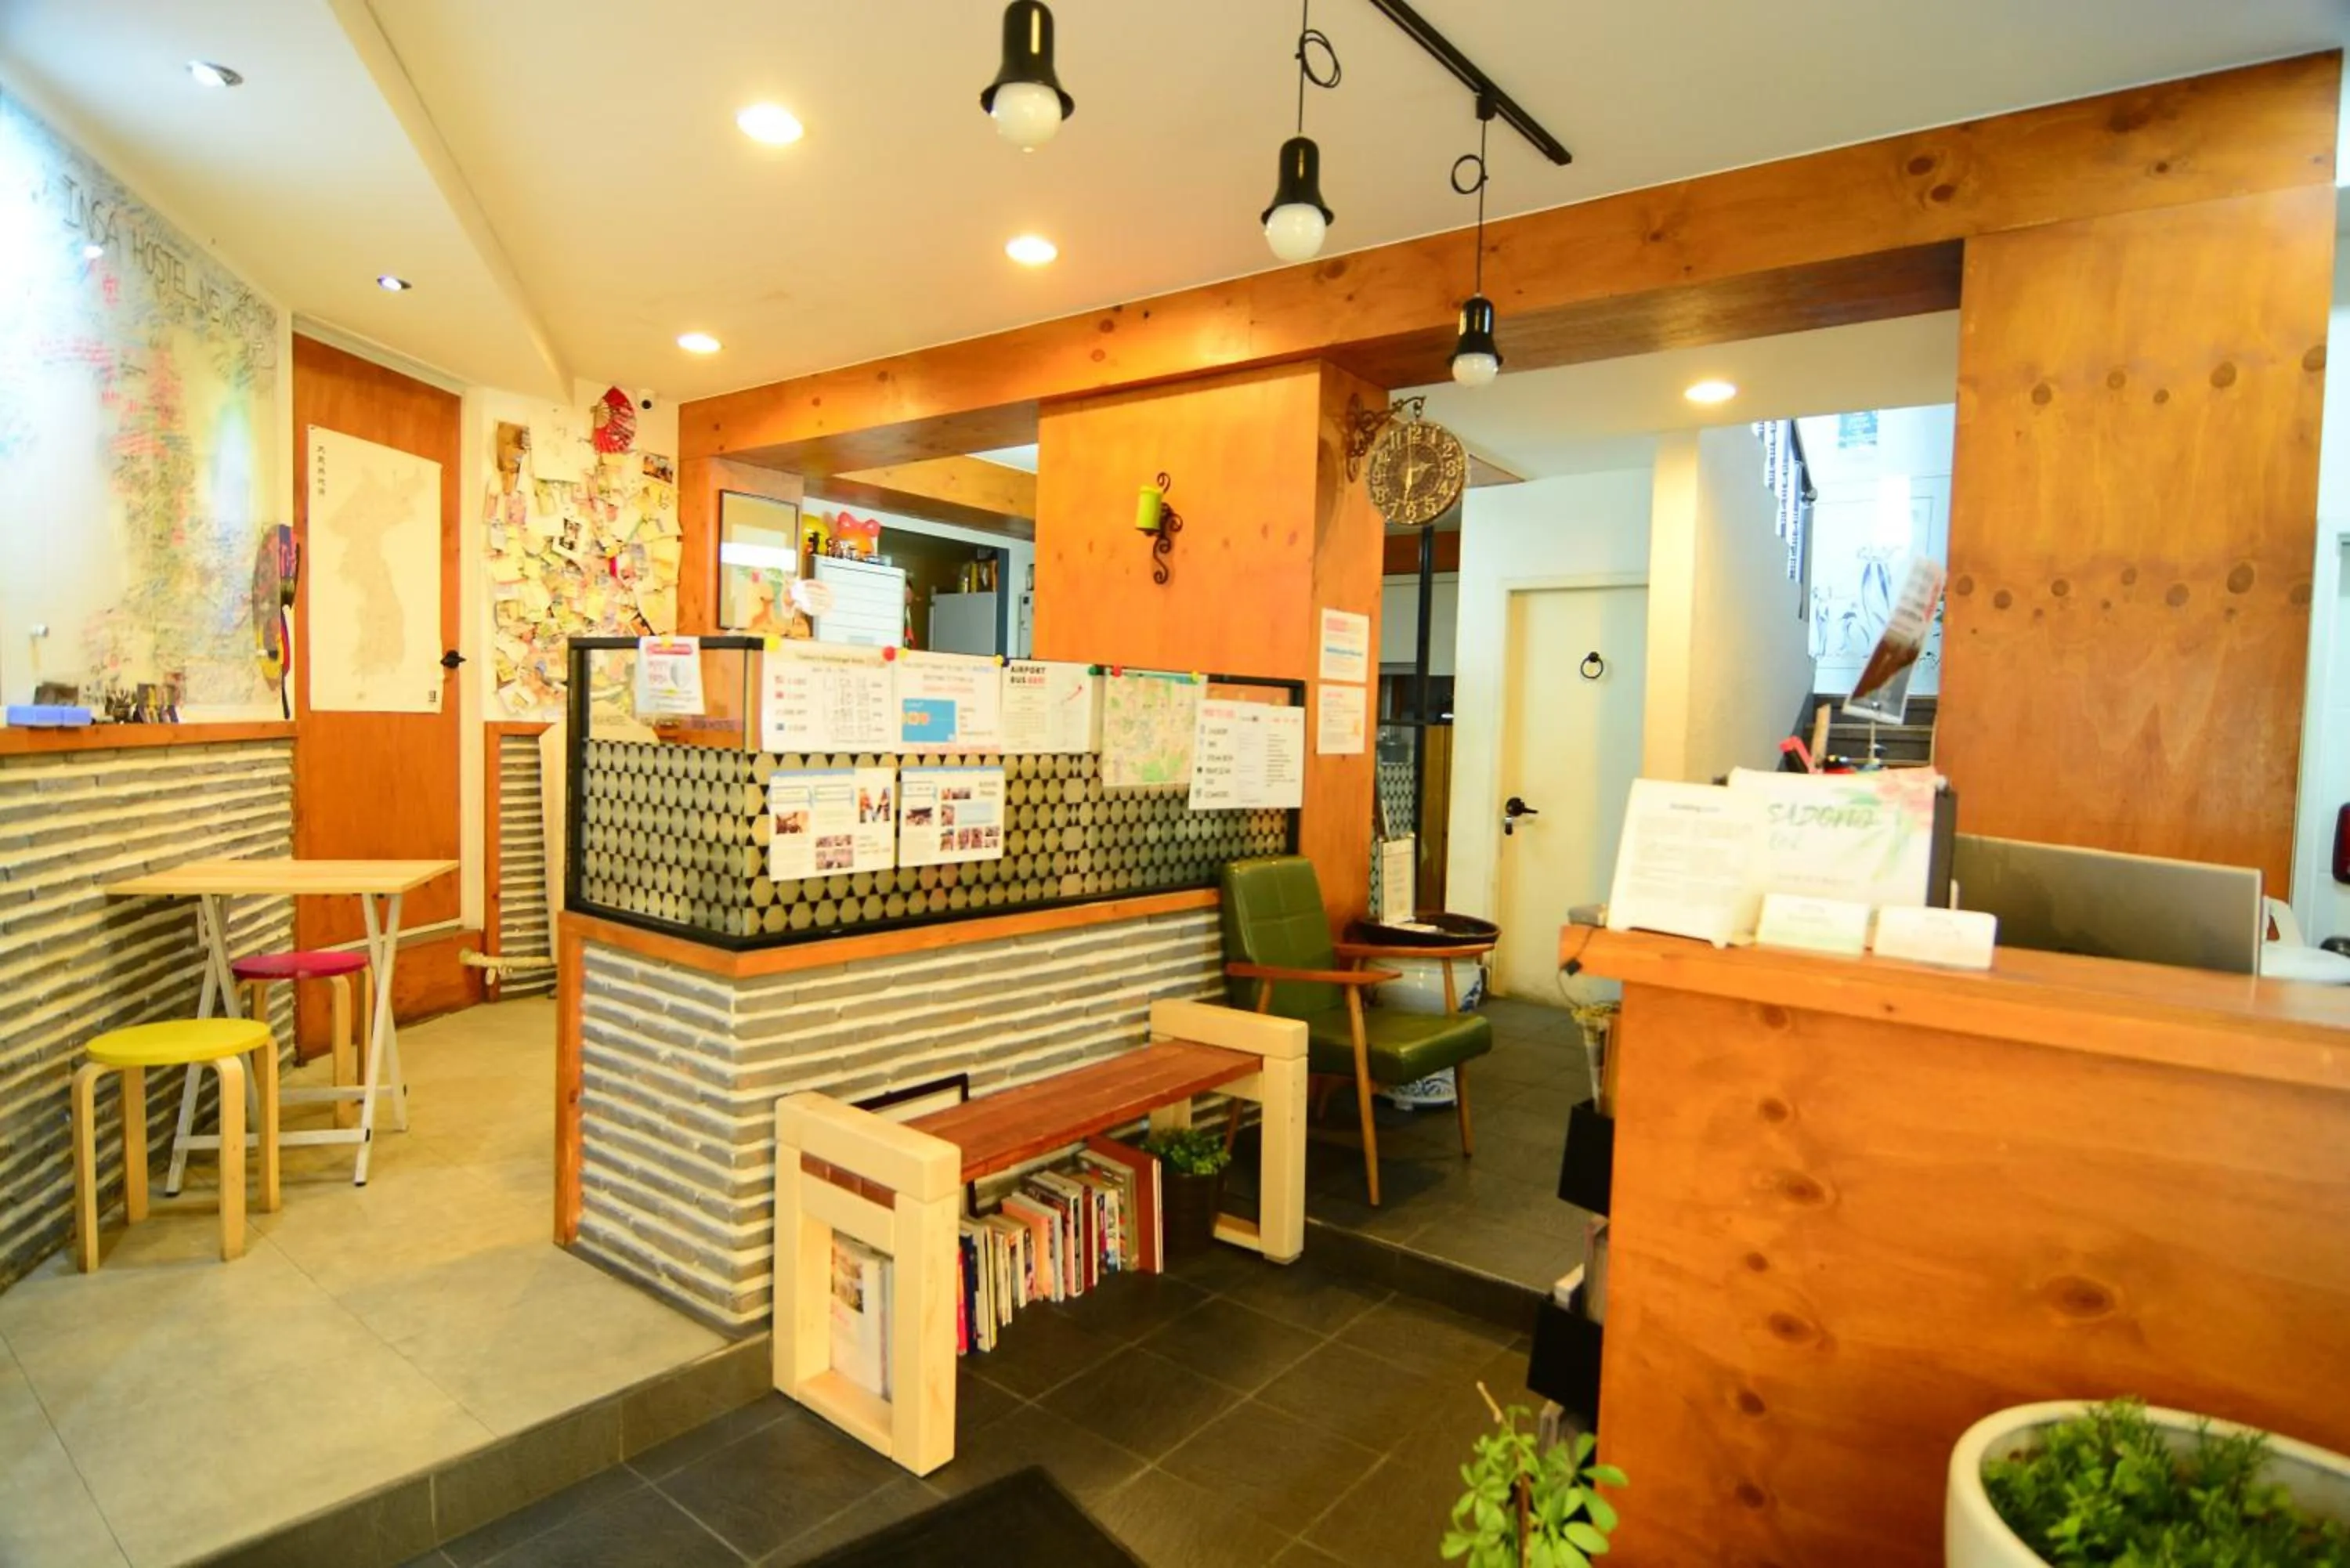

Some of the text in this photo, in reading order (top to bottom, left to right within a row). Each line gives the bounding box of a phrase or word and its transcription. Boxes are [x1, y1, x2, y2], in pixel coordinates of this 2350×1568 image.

[63, 174, 121, 263] INSA
[132, 227, 197, 302] HOSTEL
[1390, 430, 1401, 450] 11
[1442, 443, 1453, 458] 2
[1445, 460, 1457, 477] 3
[1372, 470, 1381, 484] 9
[1374, 489, 1386, 504] 8
[1437, 481, 1449, 496] 4
[1387, 502, 1399, 518] 7
[1405, 501, 1417, 519] 6
[1423, 496, 1436, 514] 5
[1010, 666, 1046, 674] AIRPORT
